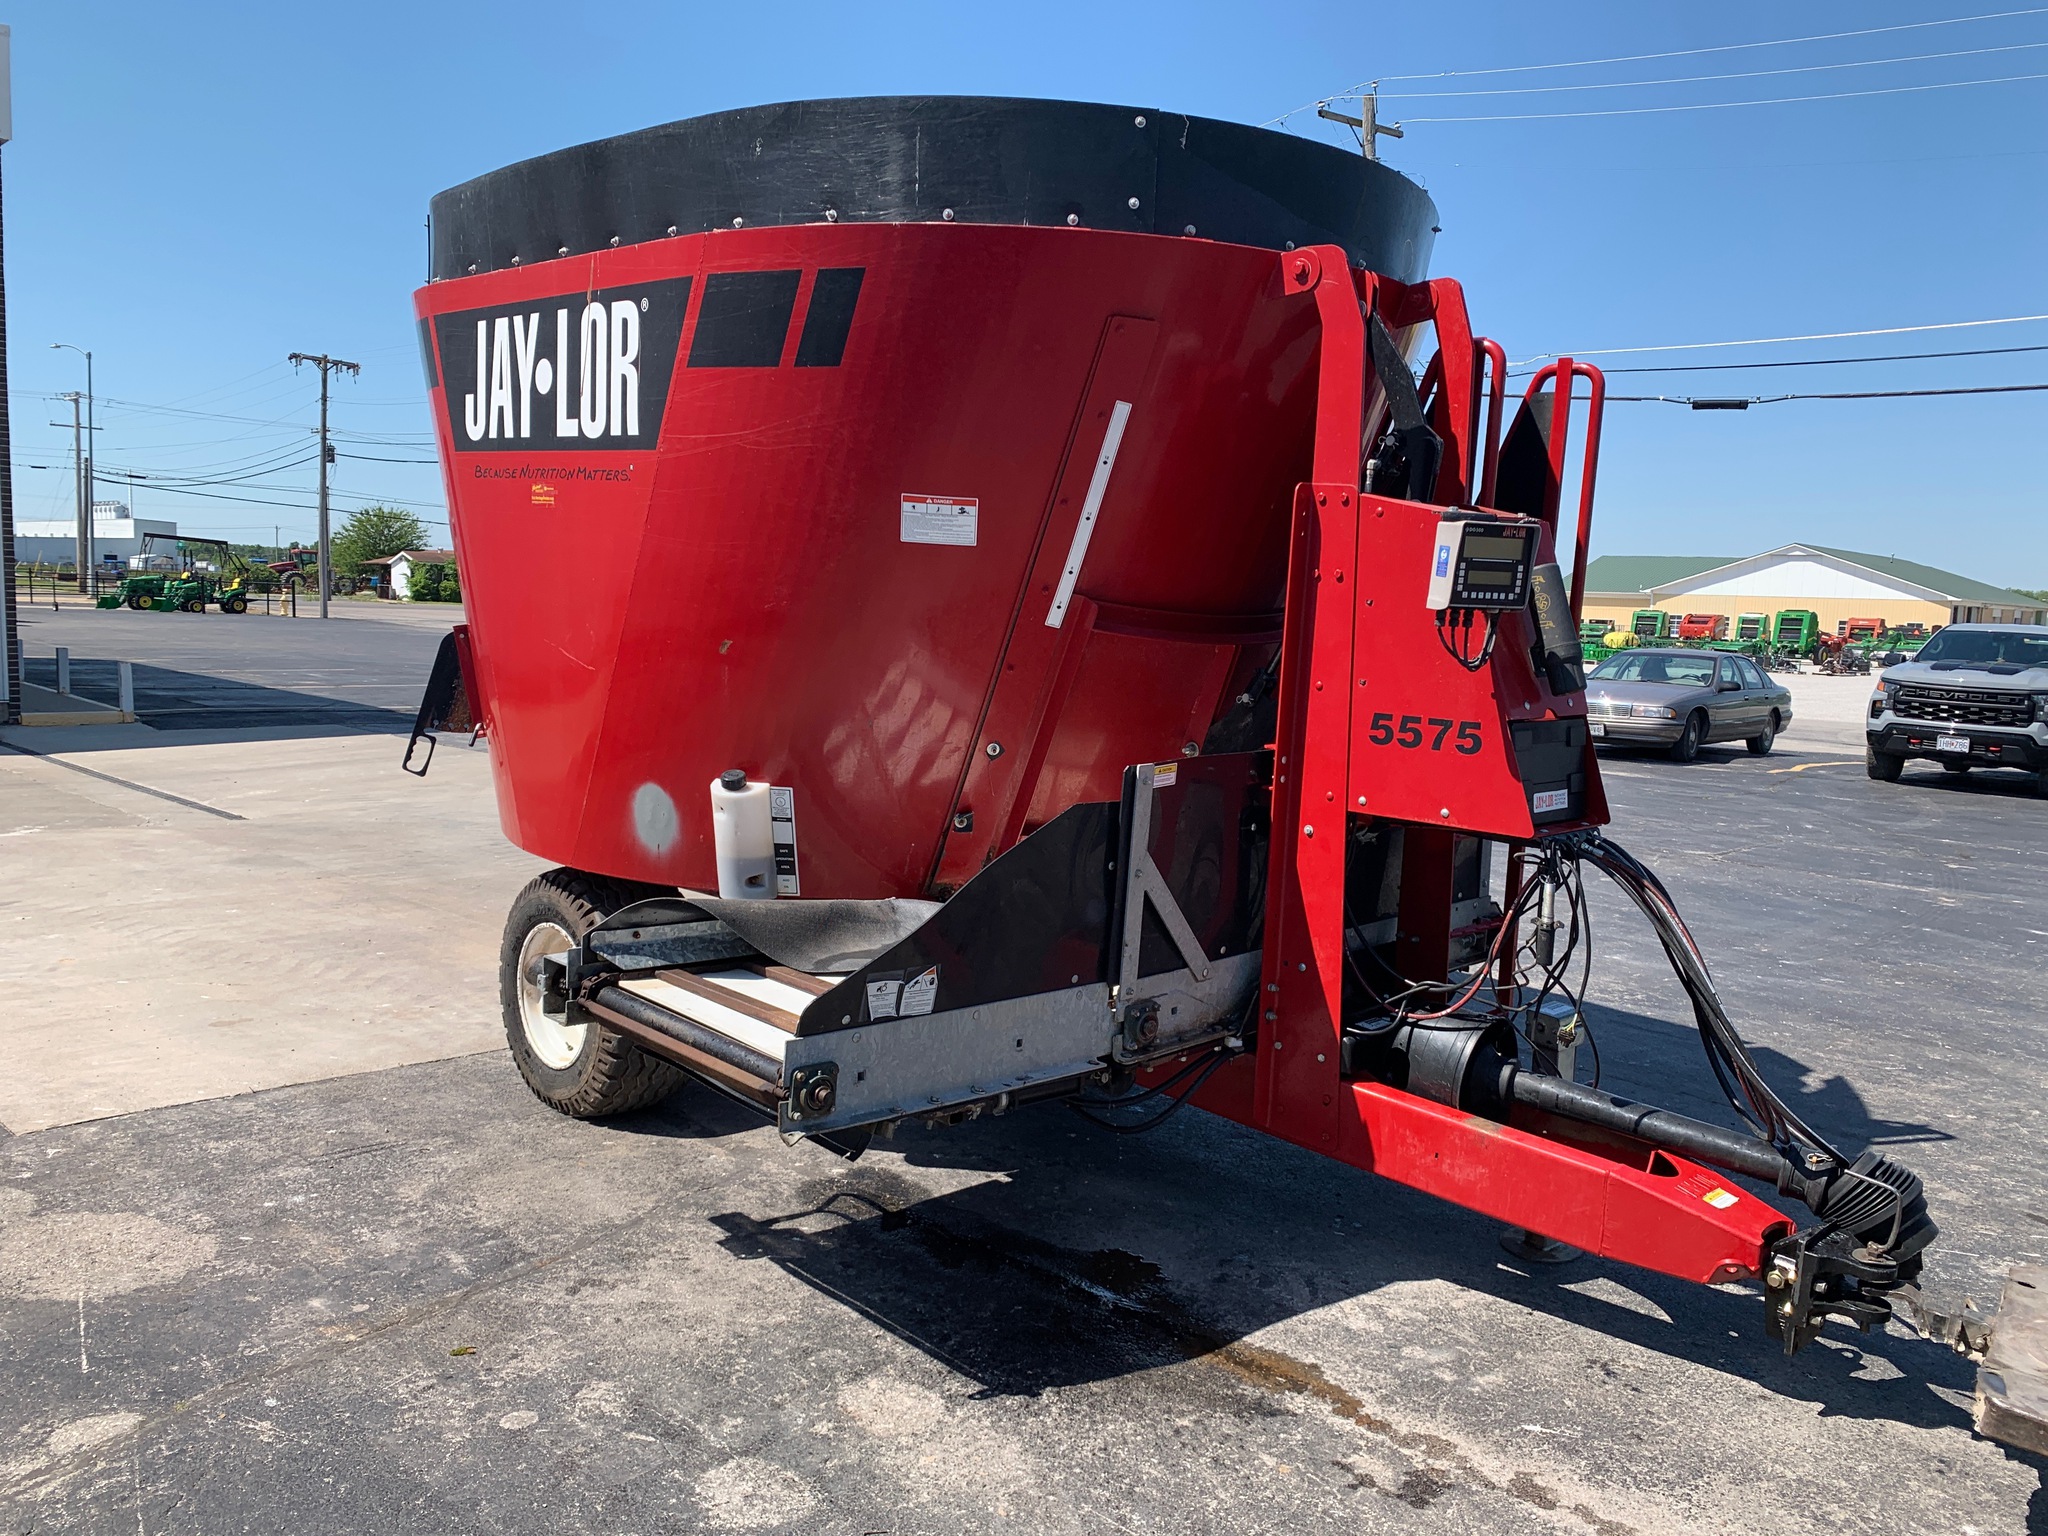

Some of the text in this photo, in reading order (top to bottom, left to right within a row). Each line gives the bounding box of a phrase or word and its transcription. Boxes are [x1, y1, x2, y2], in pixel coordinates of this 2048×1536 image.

[474, 464, 517, 479] BECAUSE
[519, 463, 575, 481] NUTRITION
[1904, 687, 2025, 704] CHEVROLET
[1368, 712, 1483, 755] 5575
